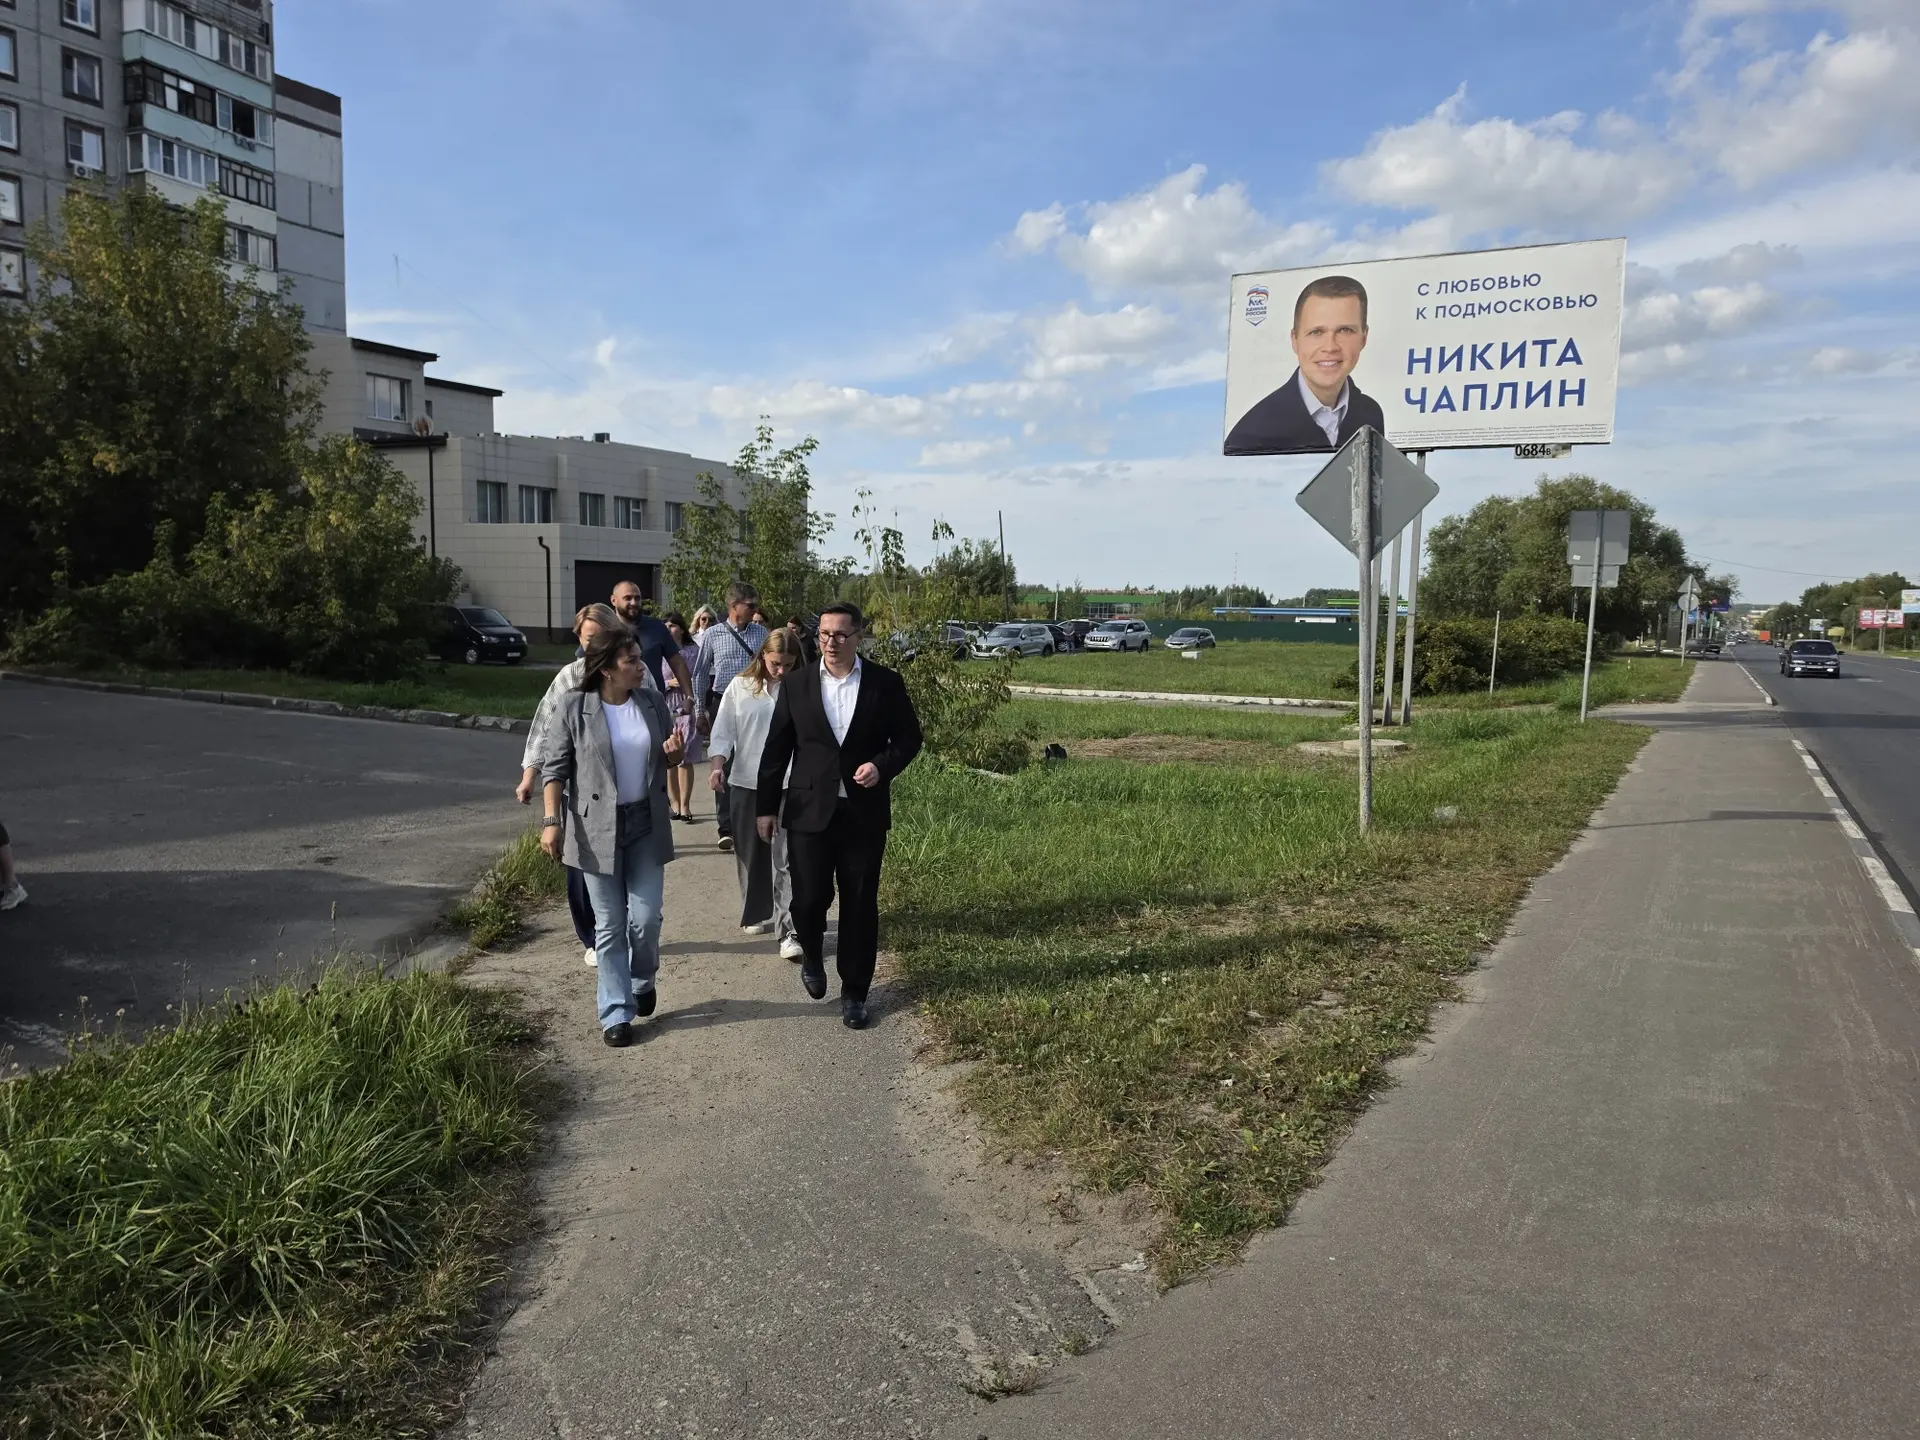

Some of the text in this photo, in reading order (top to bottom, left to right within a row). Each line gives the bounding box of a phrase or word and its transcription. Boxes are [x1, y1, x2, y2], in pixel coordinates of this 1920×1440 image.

[1417, 273, 1542, 296] С ЛЮБОВЬЮ
[1416, 294, 1598, 320] К ПОДМОСКОВЬЮ
[1407, 337, 1584, 375] НИКИТА
[1404, 378, 1586, 414] ЧАПЛИН
